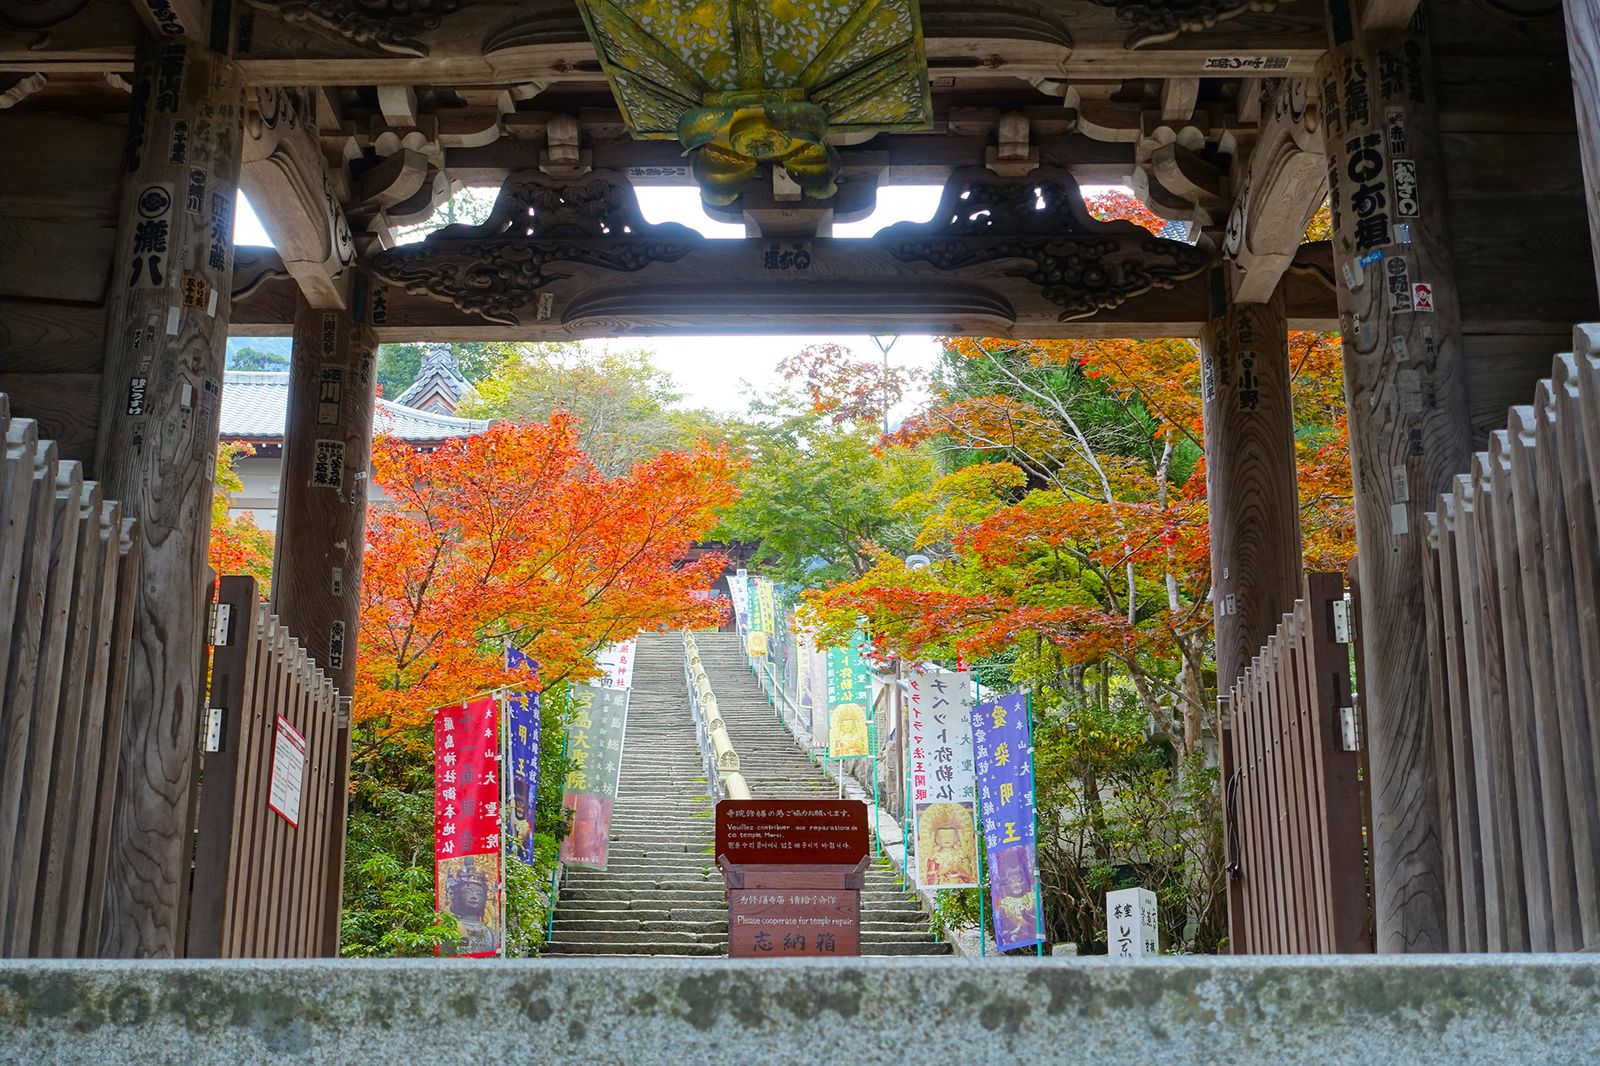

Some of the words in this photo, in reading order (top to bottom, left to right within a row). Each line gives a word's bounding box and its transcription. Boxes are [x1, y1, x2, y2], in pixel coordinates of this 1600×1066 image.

[736, 915, 761, 926] Please
[761, 917, 798, 927] cooperate
[798, 915, 809, 926] for
[810, 916, 831, 927] temple
[753, 930, 837, 952] 志納箱
